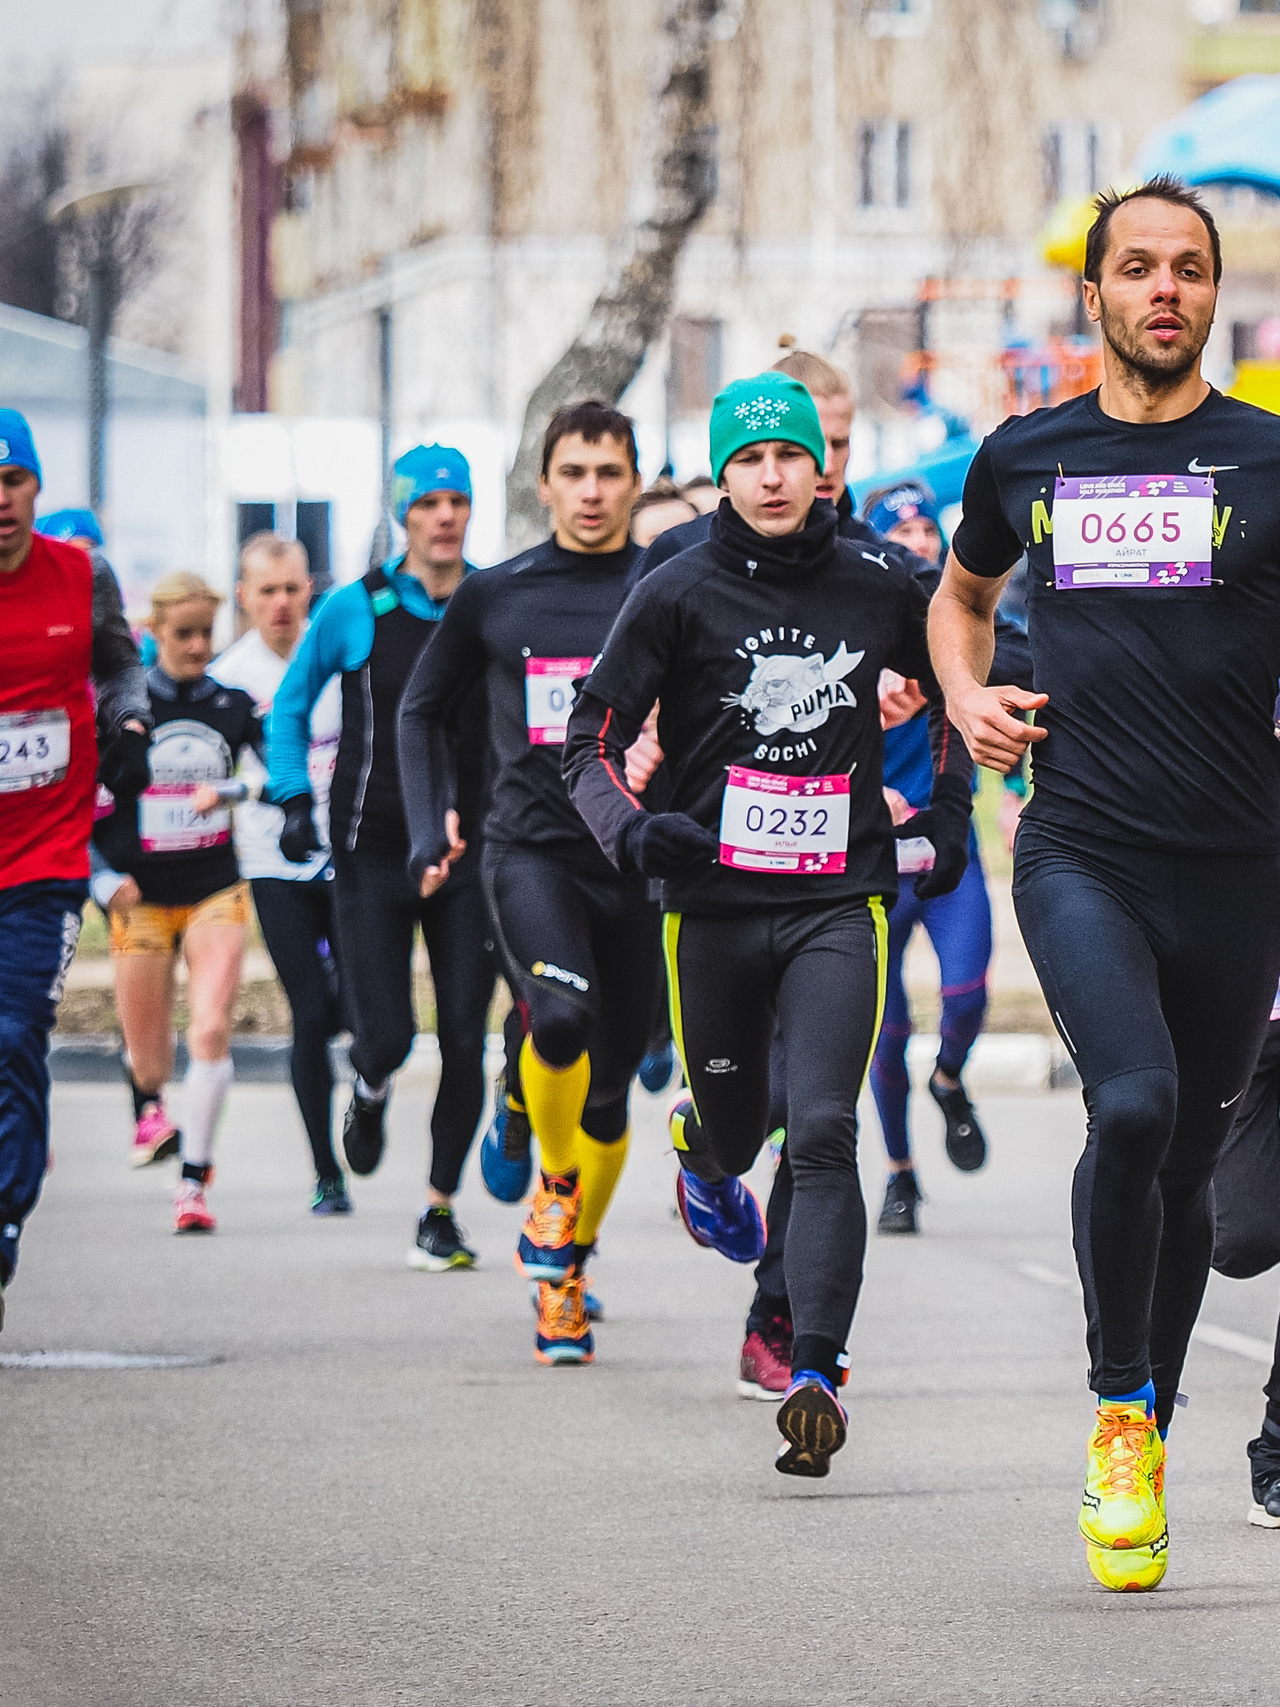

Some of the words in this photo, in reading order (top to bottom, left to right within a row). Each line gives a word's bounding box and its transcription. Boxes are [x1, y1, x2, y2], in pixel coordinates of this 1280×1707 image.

[1081, 512, 1181, 543] 0665
[1115, 547, 1147, 556] АЙРАТ
[735, 626, 816, 659] IGNITE
[790, 683, 849, 722] PUMA
[754, 738, 817, 761] SOCHI
[746, 805, 828, 836] 0232
